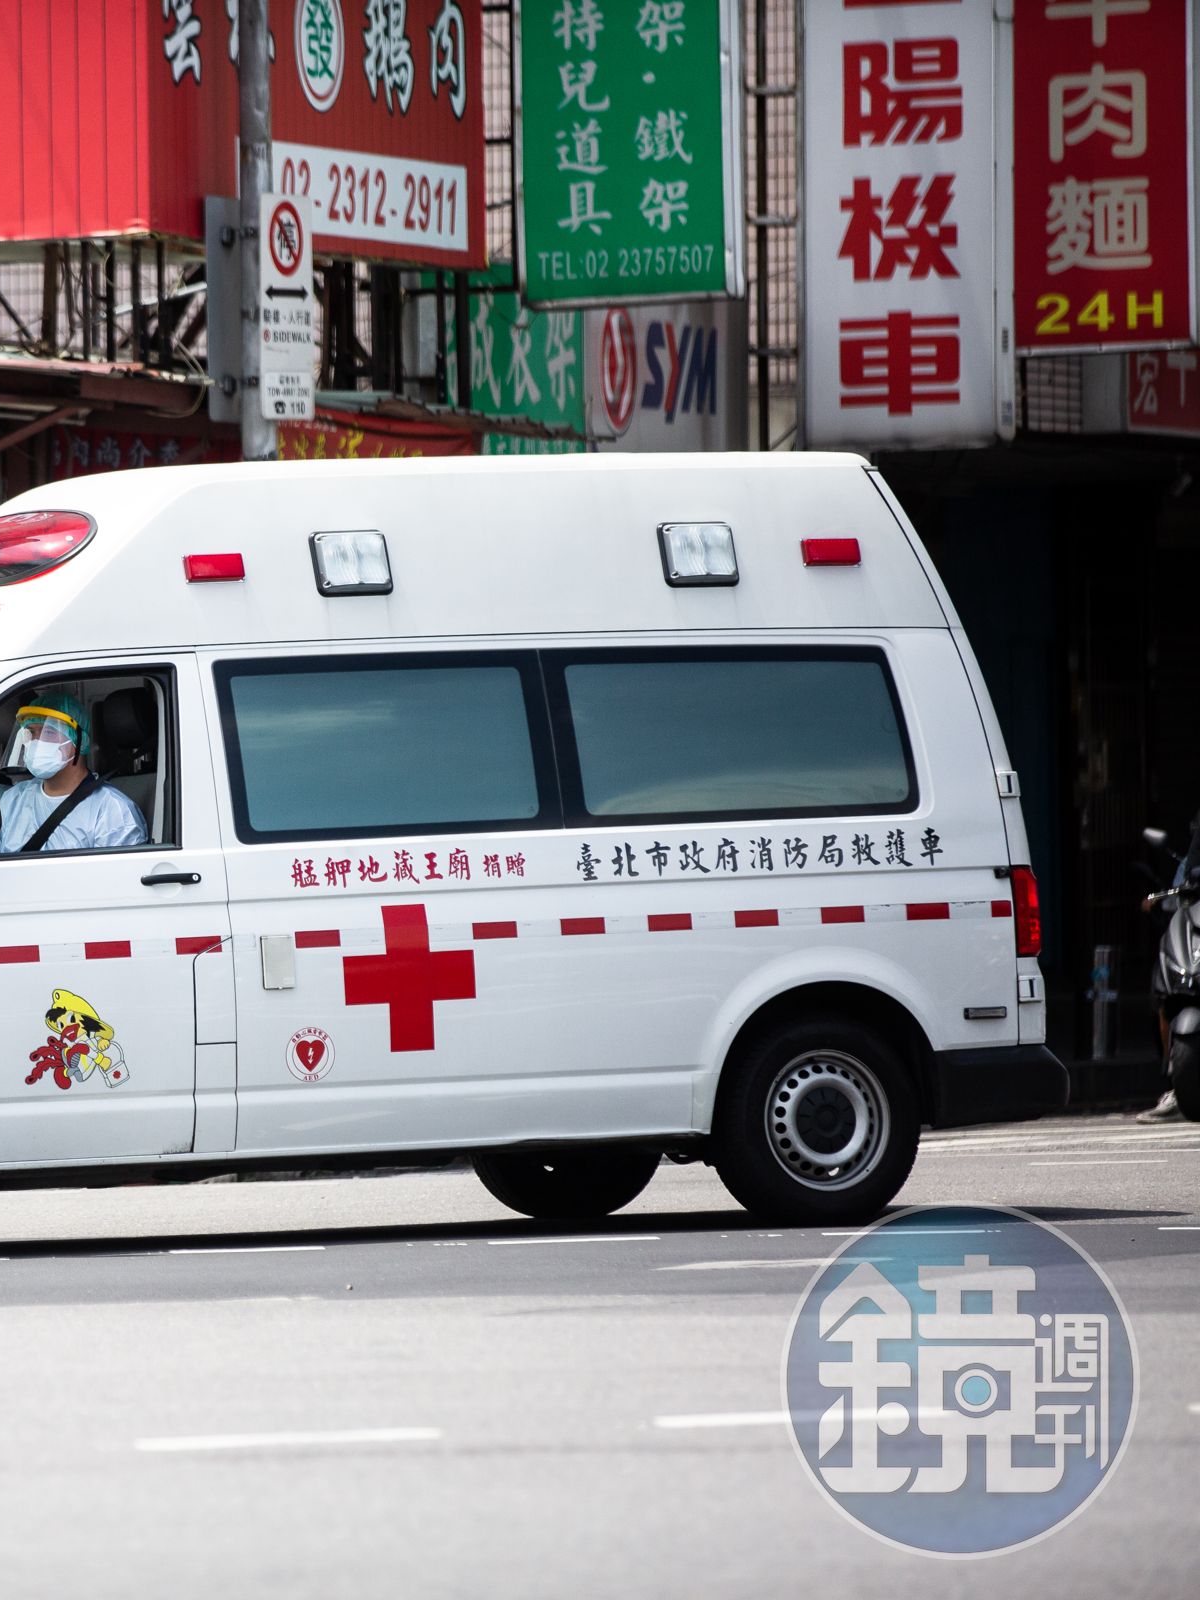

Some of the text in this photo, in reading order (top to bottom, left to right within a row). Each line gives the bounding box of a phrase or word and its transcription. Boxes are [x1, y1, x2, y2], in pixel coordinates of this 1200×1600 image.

[838, 0, 962, 416] 陽機車
[618, 245, 714, 277] 23757507
[1035, 292, 1165, 334] 24H
[273, 329, 312, 344] SIDEWALK
[642, 322, 717, 424] SYM
[290, 400, 306, 414] 110
[291, 848, 527, 888] 艋舺地藏王廟 捐贈
[576, 826, 945, 882] 臺北市政府消防局救護車
